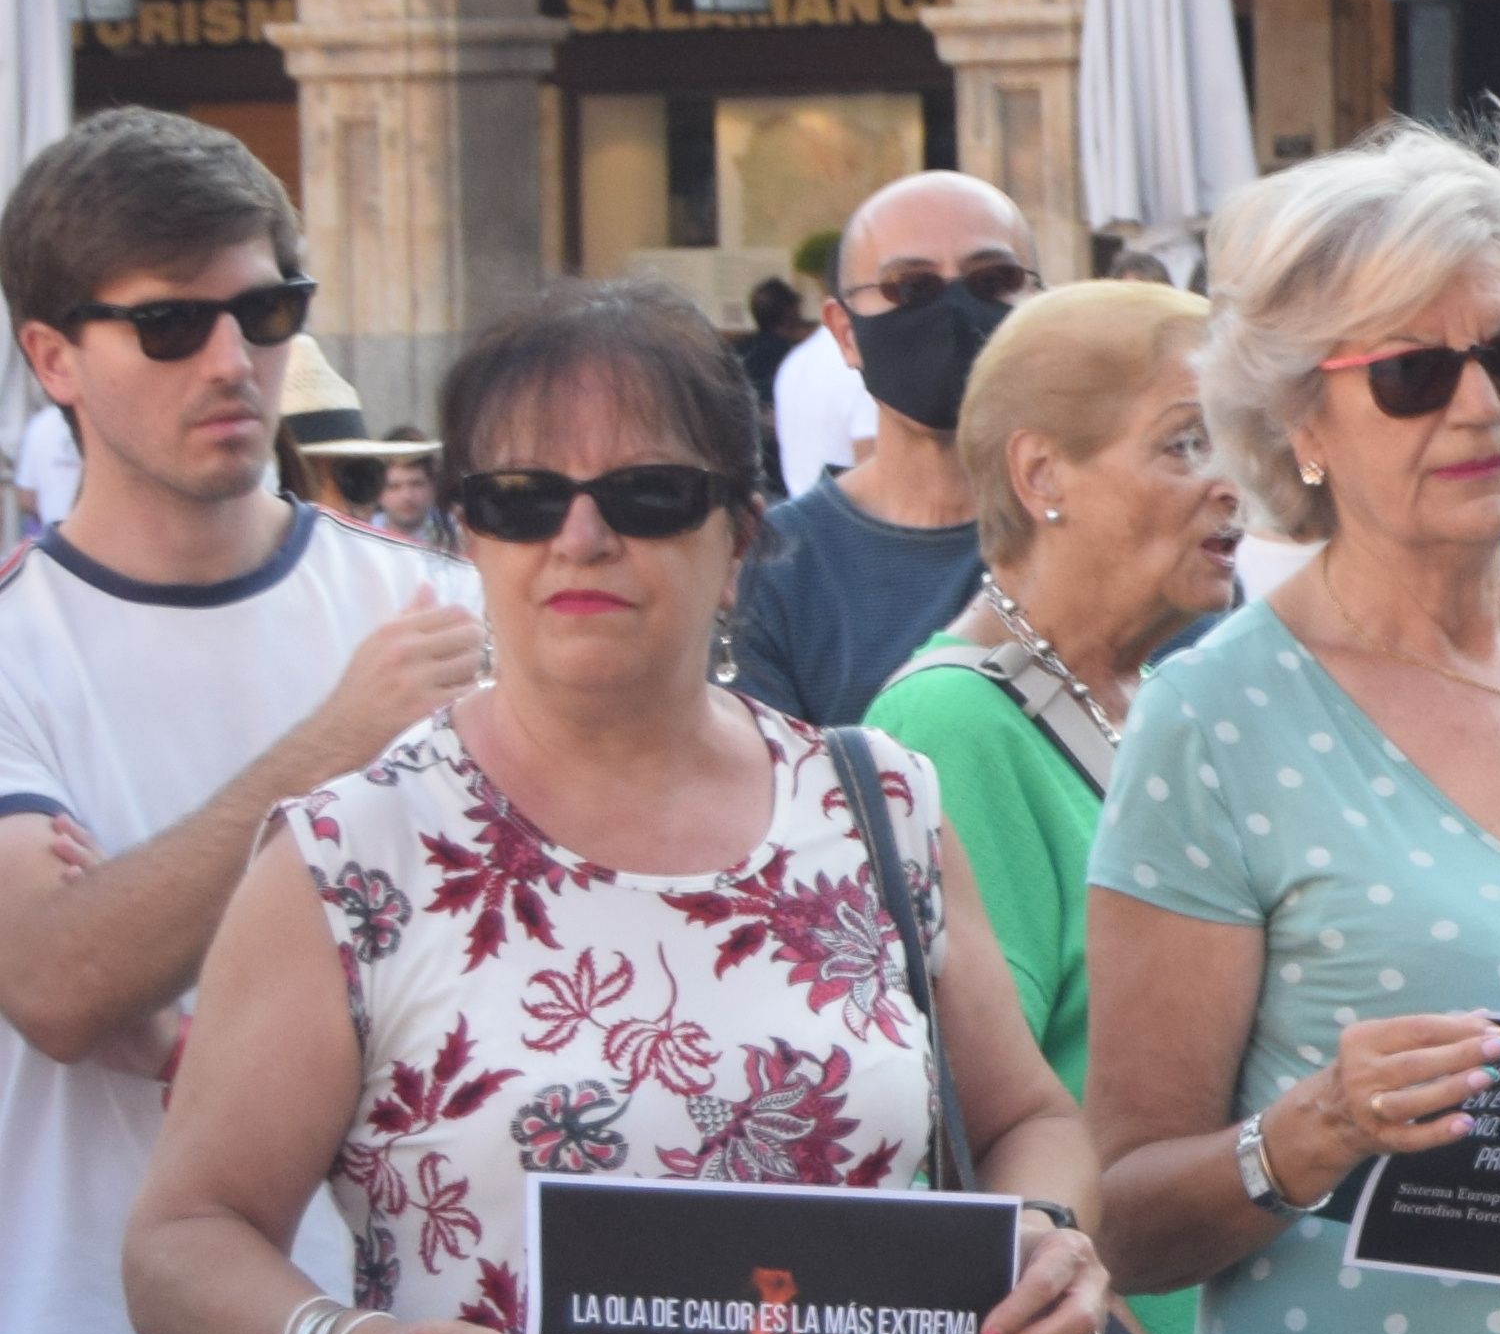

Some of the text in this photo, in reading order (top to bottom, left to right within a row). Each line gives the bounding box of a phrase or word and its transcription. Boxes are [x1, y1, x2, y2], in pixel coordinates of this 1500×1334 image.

[1469, 1113, 1500, 1138] ÑO,
[1397, 1183, 1452, 1199] Sistema
[1392, 1200, 1463, 1219] Incendios
[572, 1294, 602, 1325] LA
[607, 1296, 647, 1327] OLA
[653, 1299, 680, 1328] DE
[684, 1300, 754, 1331] CALOR
[759, 1302, 788, 1333] ES
[792, 1304, 820, 1334] LA
